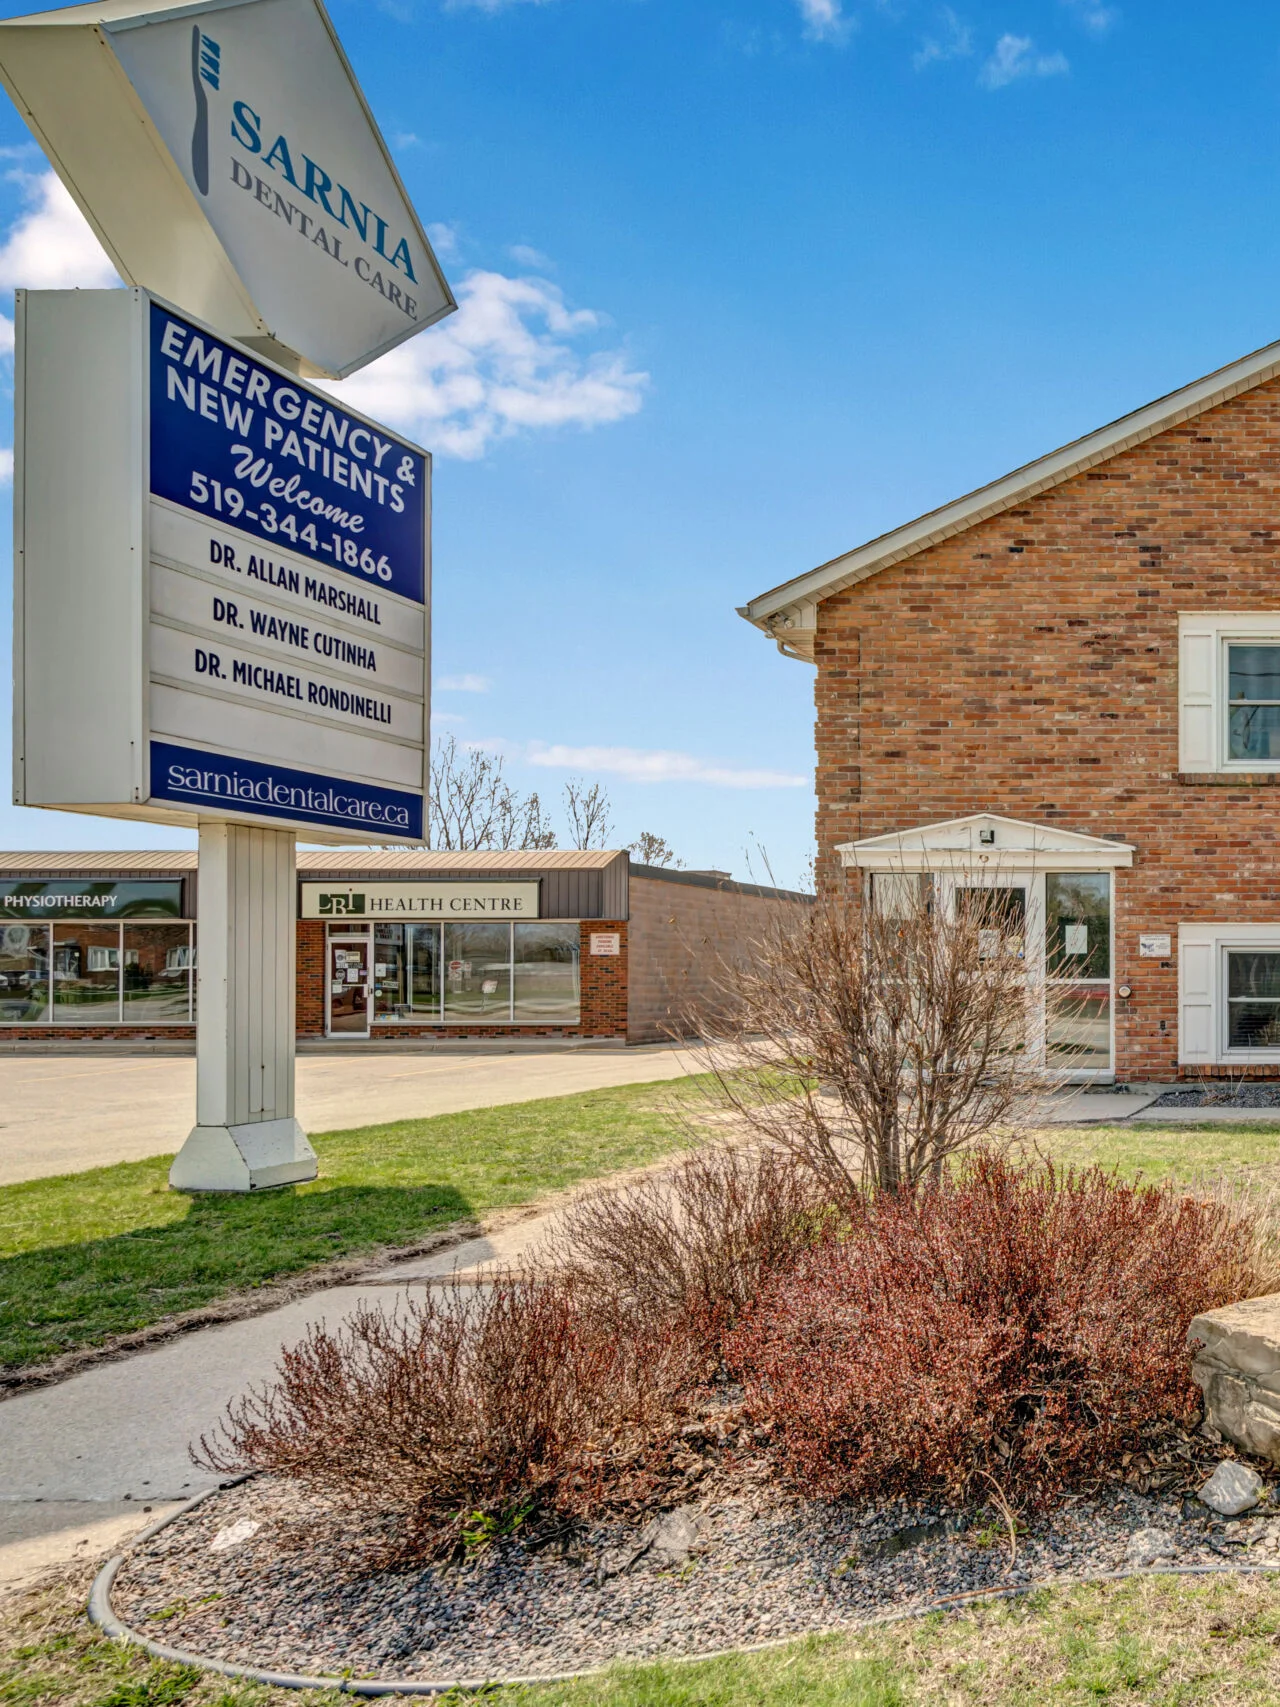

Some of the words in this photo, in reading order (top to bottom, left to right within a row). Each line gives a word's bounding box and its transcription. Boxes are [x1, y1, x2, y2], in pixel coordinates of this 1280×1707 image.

[231, 100, 418, 285] SARNIA
[229, 156, 349, 268] DENTAL
[354, 256, 418, 321] CARE
[161, 320, 392, 468] EMERGENCY
[397, 455, 416, 487] &
[166, 365, 254, 437] NEW
[264, 418, 405, 514] PATIENTS
[189, 470, 393, 582] 519-344-1866
[230, 443, 365, 534] Welcome
[209, 539, 242, 573] DR.
[247, 556, 300, 595] ALLAN
[304, 577, 381, 625] MARSHALL
[212, 597, 244, 629] DR.
[249, 609, 309, 651] WAYNE
[313, 633, 377, 673] CUTINHA
[194, 648, 227, 680] DR.
[232, 659, 304, 701] MICHAEL
[307, 681, 392, 725] RONDINELLI
[167, 762, 410, 826] sarniadentalcare.ca
[4, 895, 118, 908] PHYSIOTHERAPY
[370, 897, 443, 912] HEALTH
[449, 897, 523, 912] CENTRE
